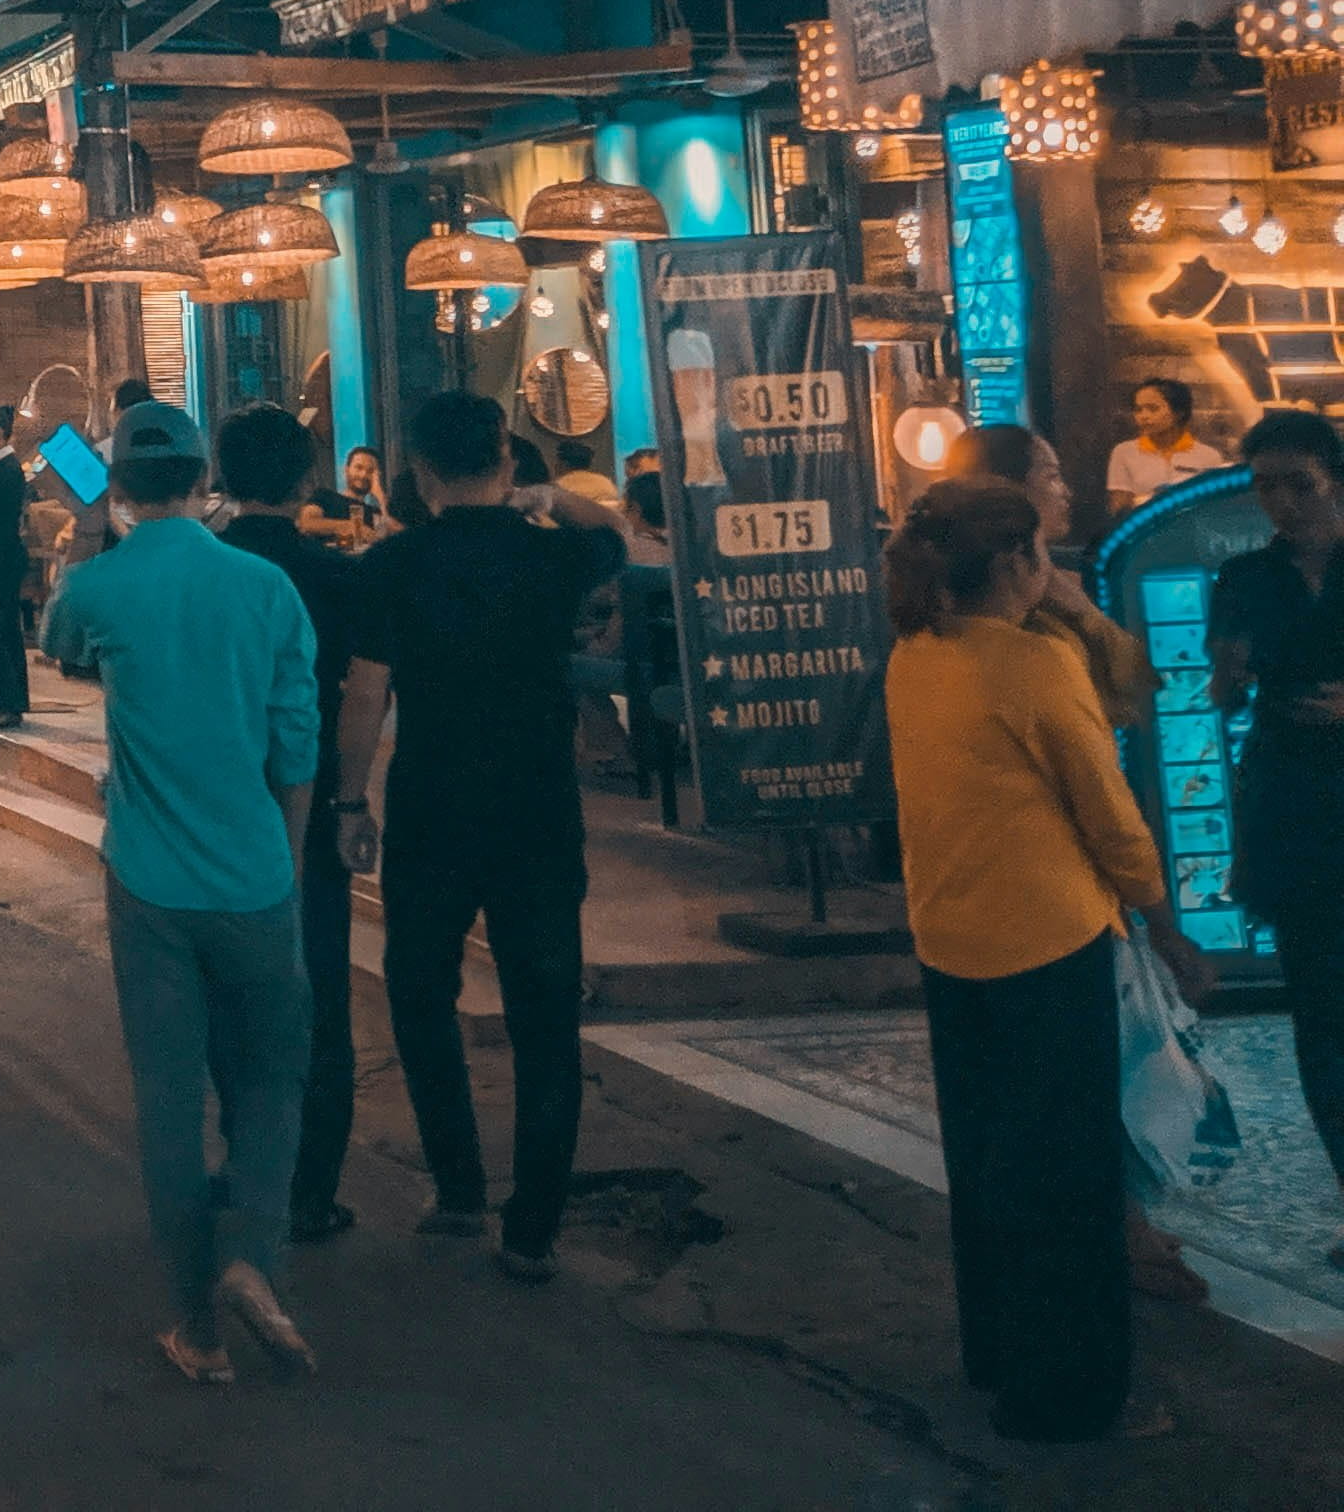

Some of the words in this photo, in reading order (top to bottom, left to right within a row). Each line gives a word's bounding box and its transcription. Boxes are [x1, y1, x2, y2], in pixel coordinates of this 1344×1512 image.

[734, 381, 830, 424] $0.50
[730, 510, 815, 551] $1.75
[720, 573, 784, 602] LONG
[786, 567, 868, 599] ISLAND
[725, 605, 779, 633] ICED
[783, 602, 826, 630] TEA
[730, 646, 865, 681] MARGARITA
[735, 698, 822, 730] MOJITO
